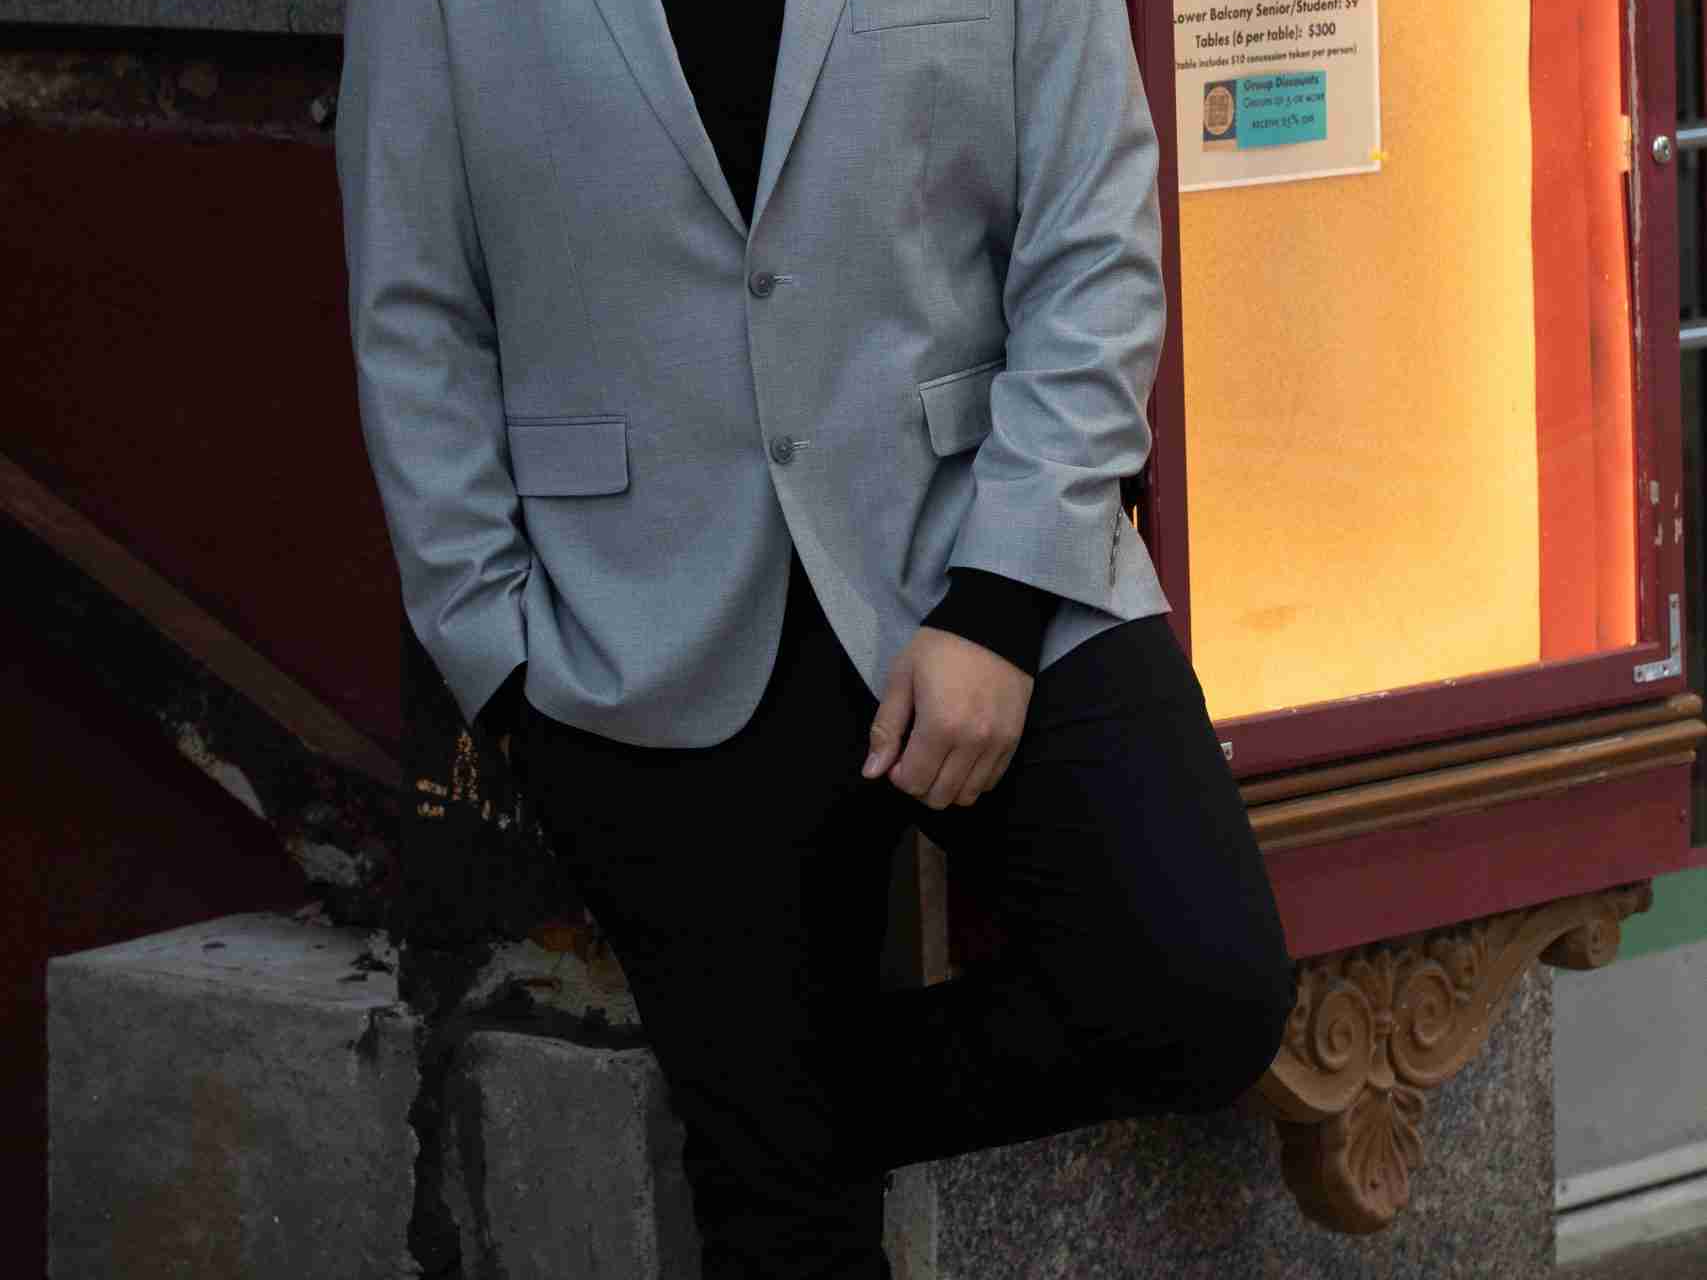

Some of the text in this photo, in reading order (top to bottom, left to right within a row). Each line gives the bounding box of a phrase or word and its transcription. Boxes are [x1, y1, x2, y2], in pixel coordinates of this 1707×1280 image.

[1208, 3, 1253, 24] Balcony
[1194, 21, 1337, 49] Tables (6 per table): $300
